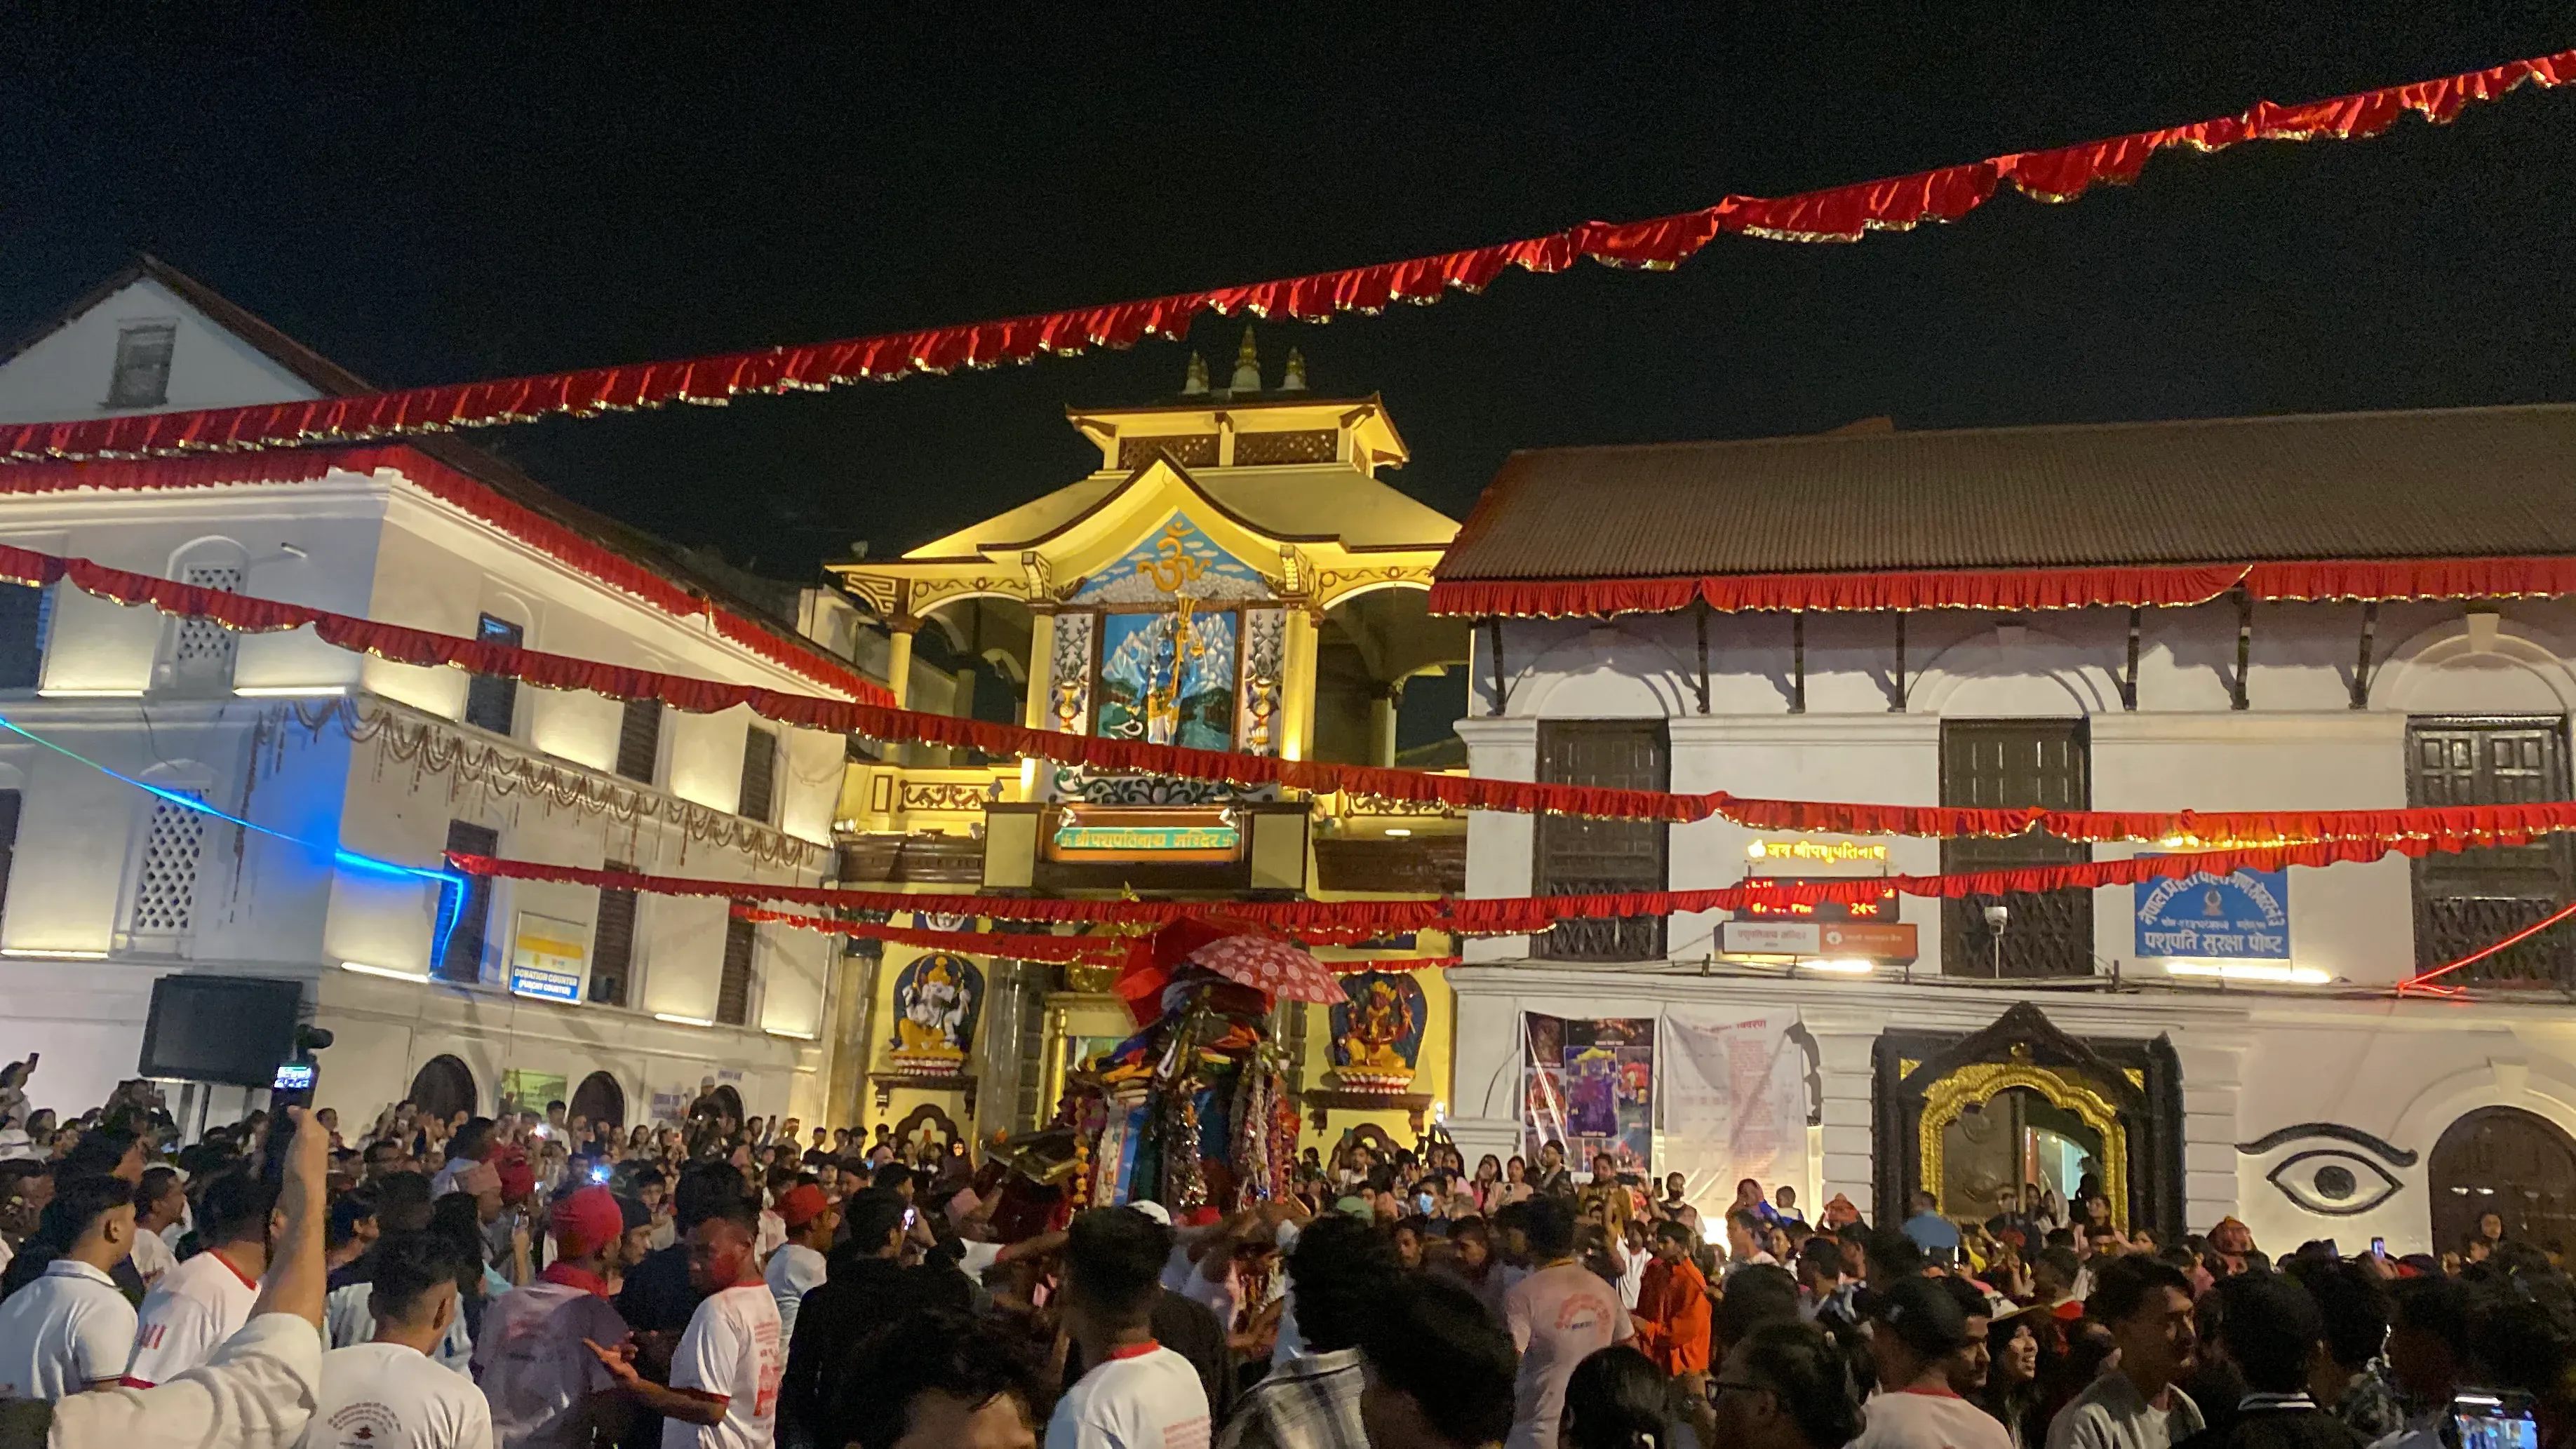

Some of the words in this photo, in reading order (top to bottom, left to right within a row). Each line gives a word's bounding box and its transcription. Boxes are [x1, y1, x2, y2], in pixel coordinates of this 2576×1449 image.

[2145, 929, 2199, 955] पशुपति
[2203, 934, 2244, 955] सुरक्षा
[2248, 931, 2283, 953] पोष्ट
[515, 968, 548, 981] DONATION
[548, 973, 577, 986] COUNTER
